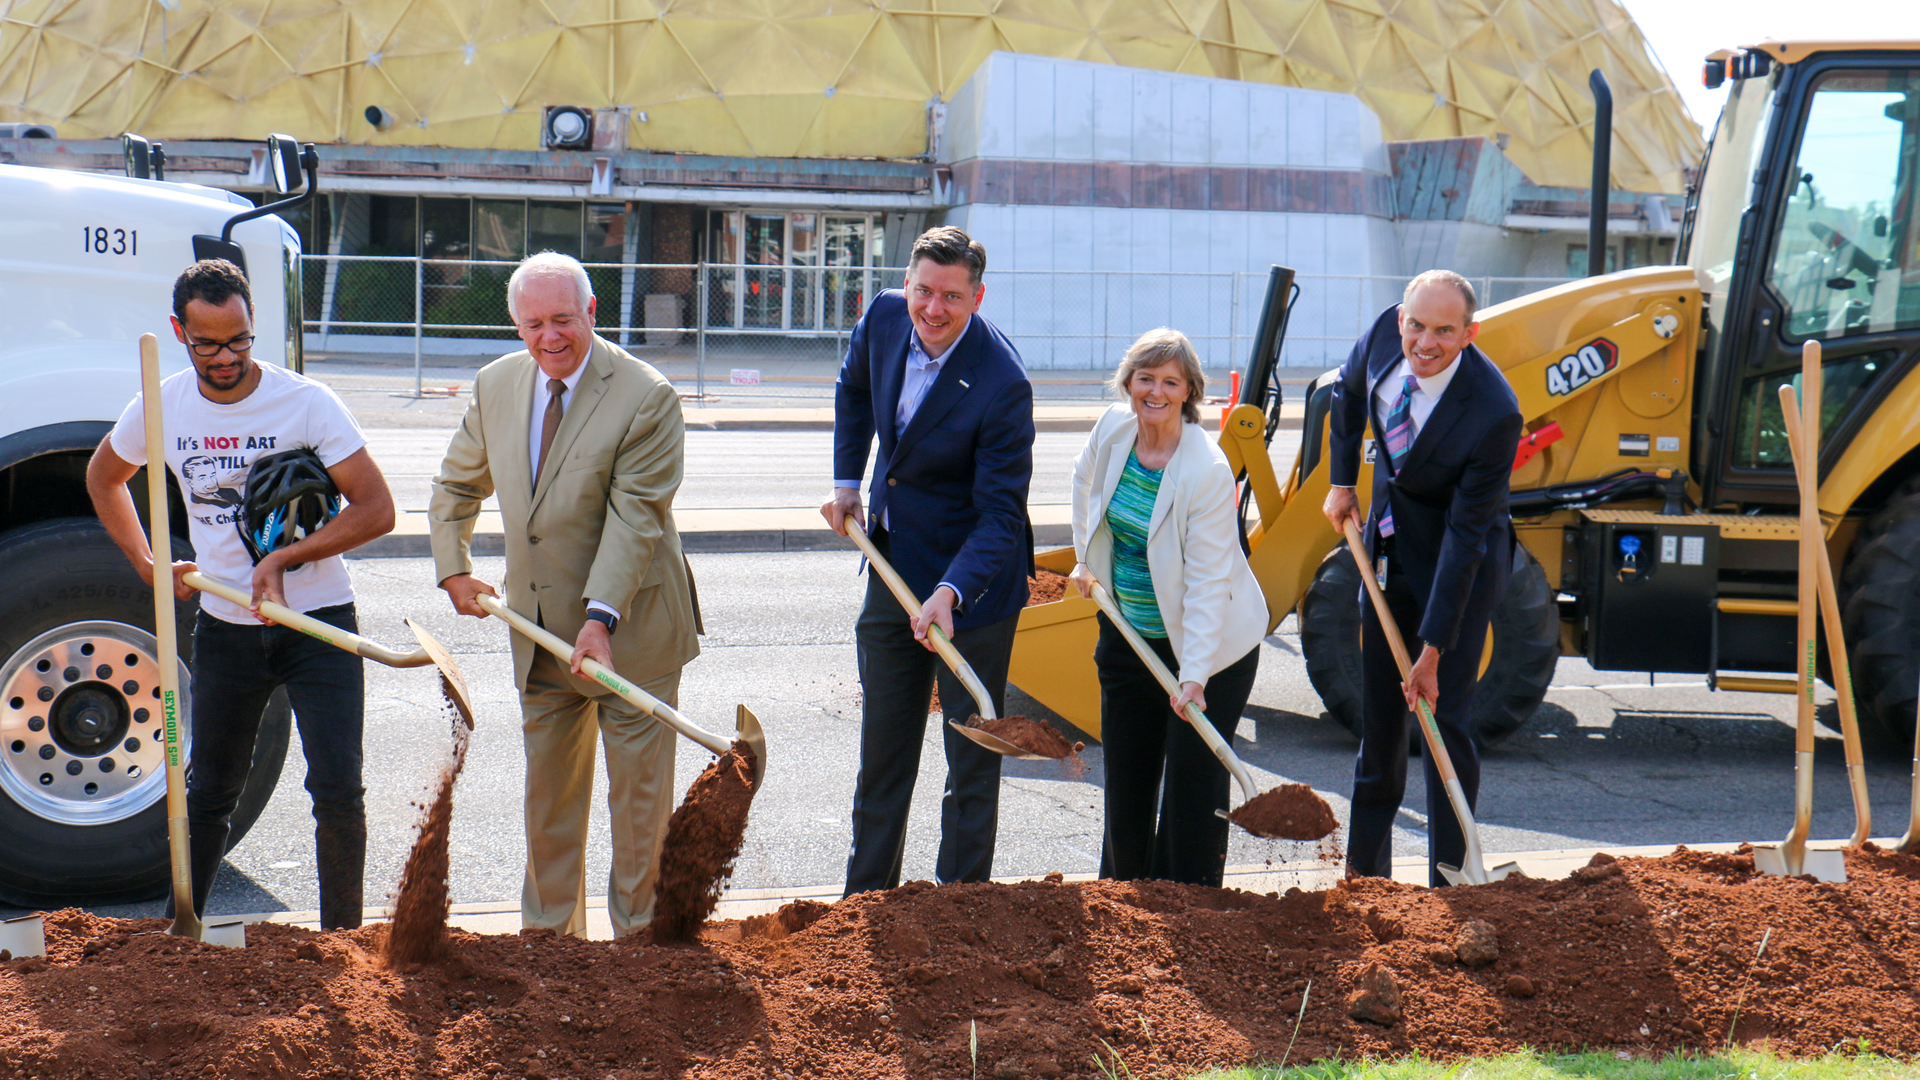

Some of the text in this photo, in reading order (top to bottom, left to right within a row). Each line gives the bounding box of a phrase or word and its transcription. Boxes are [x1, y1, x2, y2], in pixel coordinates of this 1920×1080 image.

[84, 226, 137, 256] 1831
[1547, 345, 1606, 395] 420
[177, 436, 277, 451] It's NOT ART
[56, 582, 132, 602] 425/65
[164, 690, 178, 766] SEYMOUR S300
